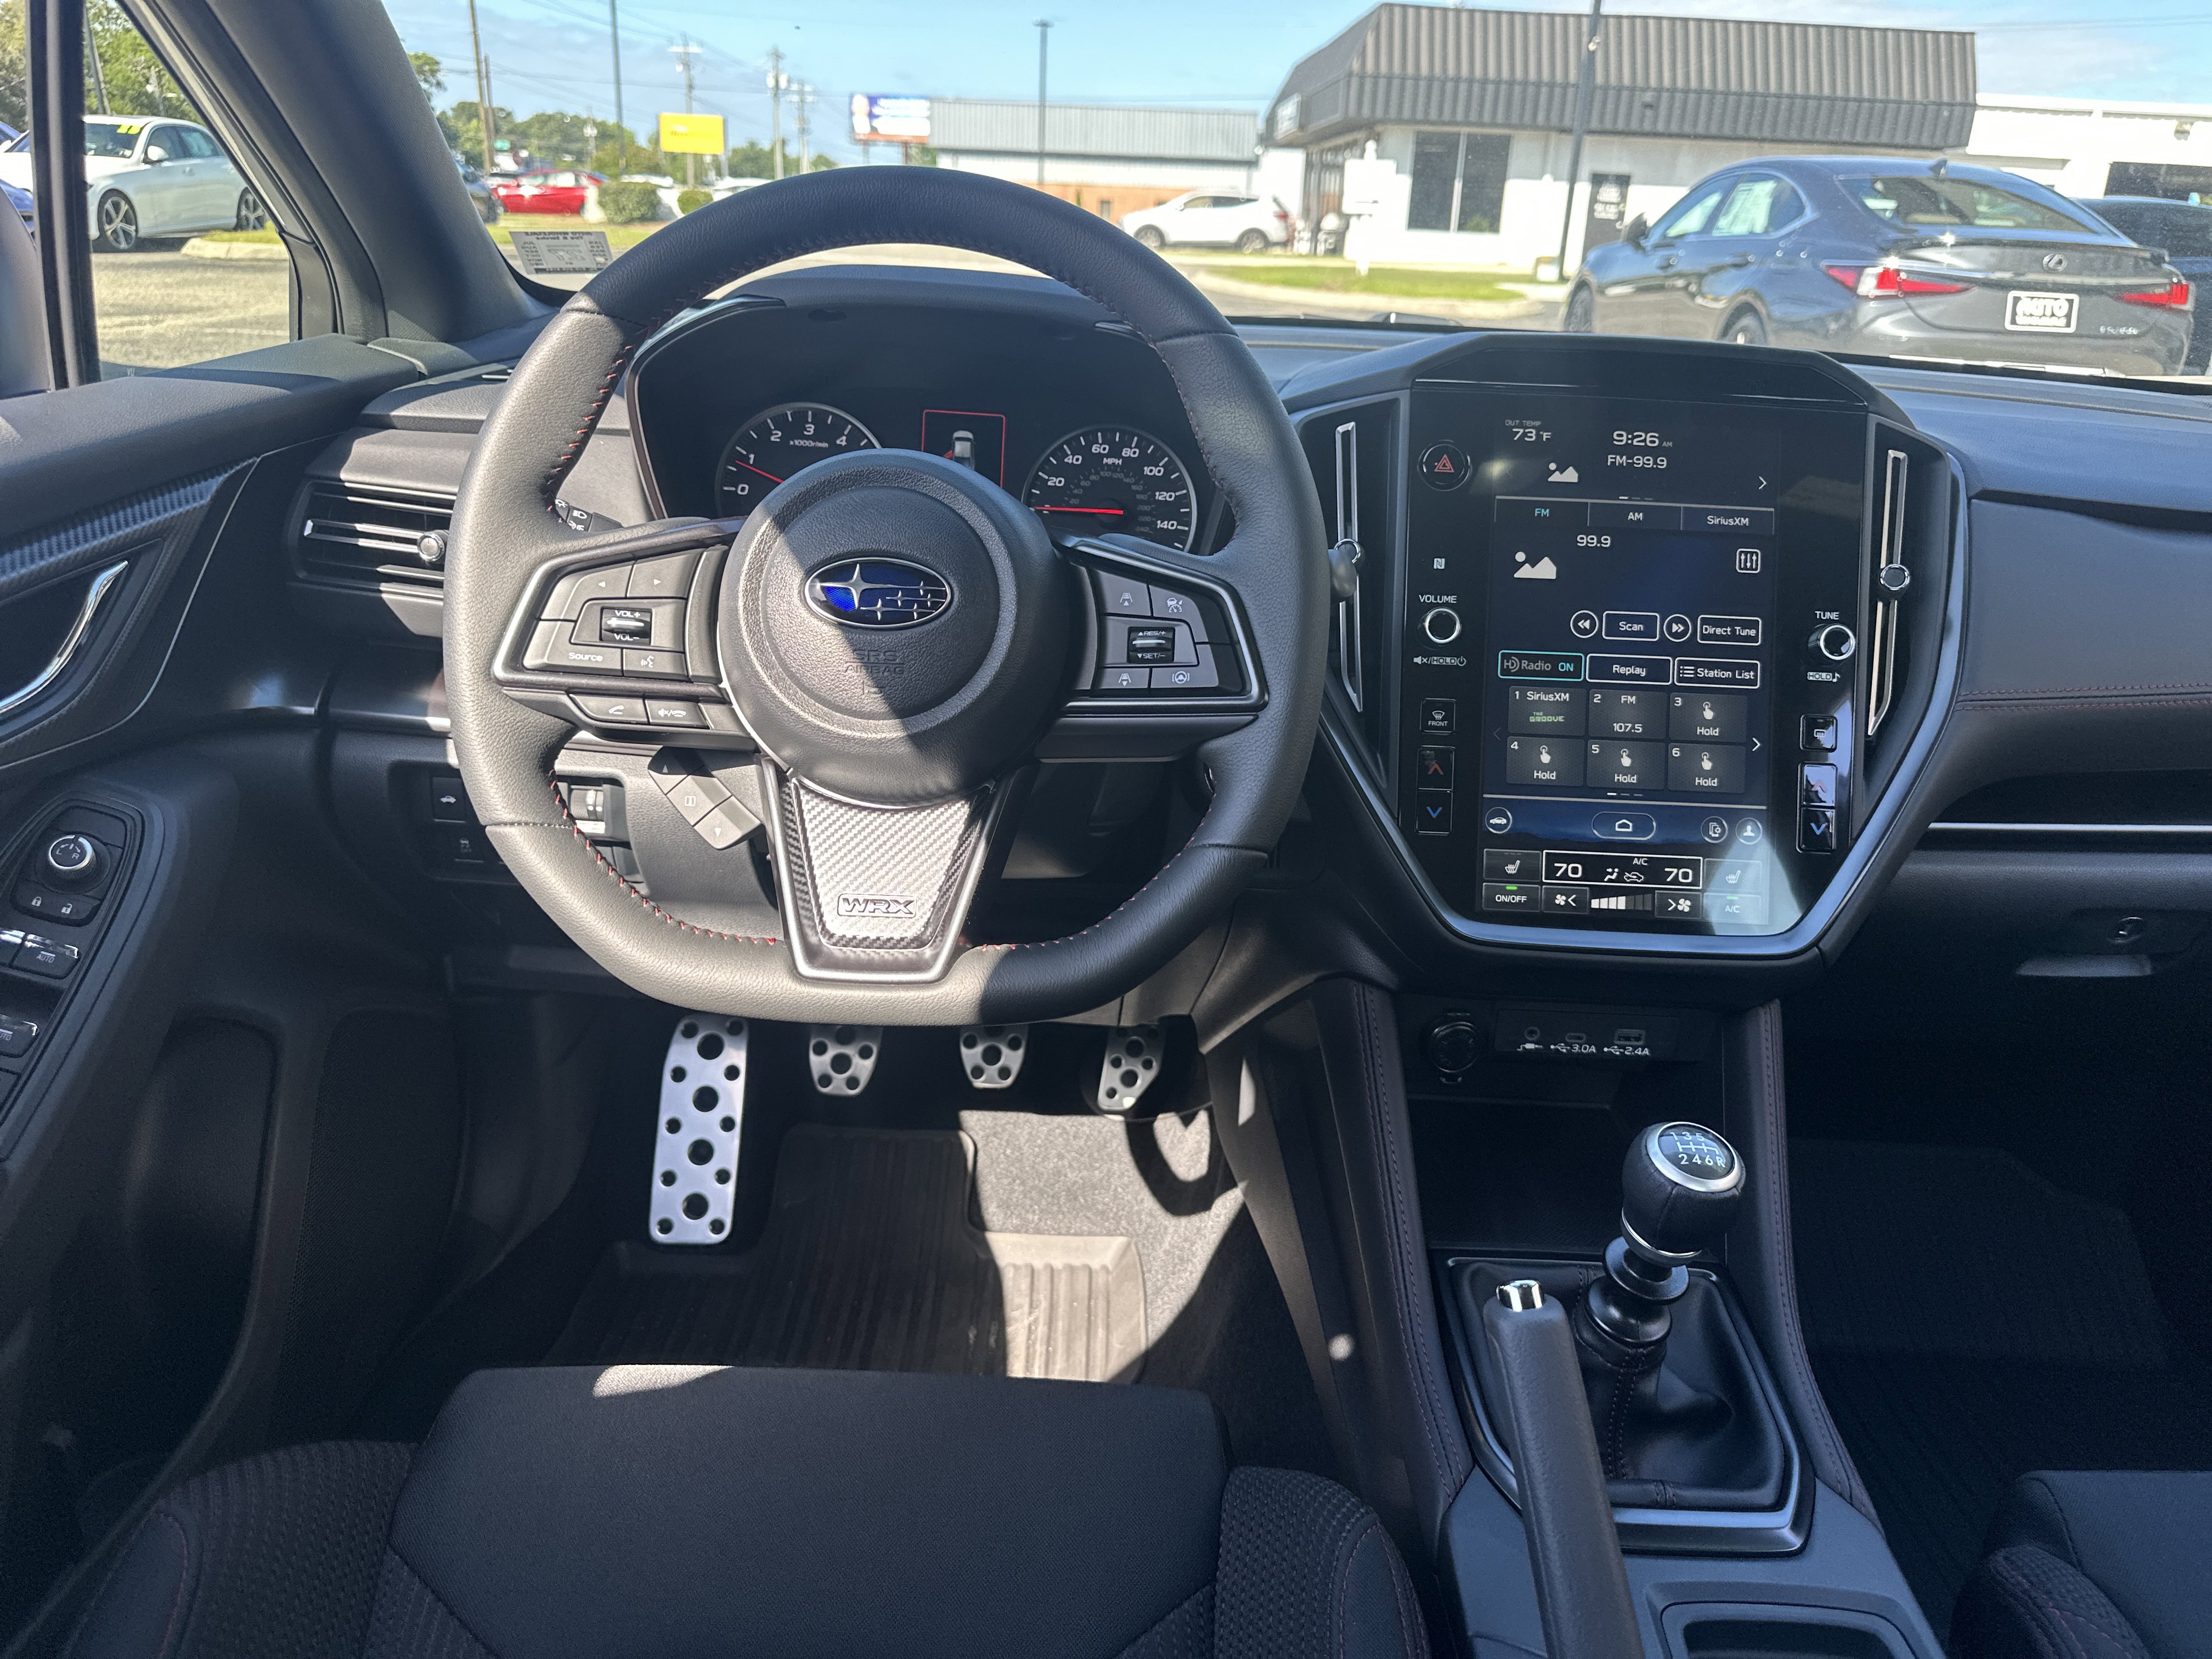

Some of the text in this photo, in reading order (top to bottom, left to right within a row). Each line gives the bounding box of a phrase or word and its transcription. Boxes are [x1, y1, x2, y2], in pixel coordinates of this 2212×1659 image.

[803, 424, 815, 436] 3
[1512, 428, 1536, 442] 73
[770, 431, 782, 442] 2
[836, 436, 847, 447] 4
[1613, 431, 1660, 447] 9:26
[789, 439, 828, 448] x1000r/min
[1092, 444, 1109, 454] 60
[1122, 448, 1139, 458] 80
[748, 454, 755, 464] 1
[1064, 455, 1082, 465] 40
[1607, 455, 1667, 469] FM-99.9
[1143, 466, 1164, 476] 100
[1047, 477, 1065, 487] 20
[737, 484, 749, 495] 0
[1155, 492, 1175, 501] 120
[1534, 507, 1550, 517] FM
[1628, 512, 1643, 521] AM
[1156, 520, 1177, 530] 140
[1707, 516, 1750, 526] SiriusXM
[1577, 534, 1611, 548] 99.9
[1419, 595, 1457, 603] VOLUME
[1815, 611, 1839, 620] TUNE
[1619, 621, 1644, 632] Scan
[1702, 625, 1756, 636] Direct Tune
[569, 652, 603, 662] Source
[853, 650, 898, 662] SRS
[844, 665, 905, 674] AIRBAG
[1521, 659, 1551, 671] Radio
[1558, 662, 1574, 672] ON
[1612, 664, 1646, 676] Replay
[1697, 668, 1754, 680] Station List
[1515, 691, 1570, 702] 1 SiriusXM
[1593, 694, 1636, 704] 2 FM
[1674, 697, 1682, 706] 3
[1613, 723, 1643, 733] 107.5
[1697, 726, 1719, 736] Hold
[1510, 741, 1519, 750] 4
[1591, 744, 1599, 754] 5
[1672, 748, 1680, 757] 6
[1533, 770, 1556, 780] Hold
[1615, 774, 1637, 783] Hold
[1695, 777, 1717, 787] Hold
[1633, 858, 1648, 866] A/C
[1554, 863, 1582, 878] 70
[1664, 868, 1693, 883] 70
[1495, 894, 1527, 904] ON/OFF
[842, 898, 915, 915] WRX
[1725, 905, 1740, 913] A/C
[36, 953, 55, 963] AUTO
[1571, 1044, 1596, 1053] 3.0A
[1624, 1047, 1650, 1056] 2.4A
[1670, 1131, 1705, 1142] 1 3 5
[1678, 1153, 1726, 1168] 2 4 6 R
